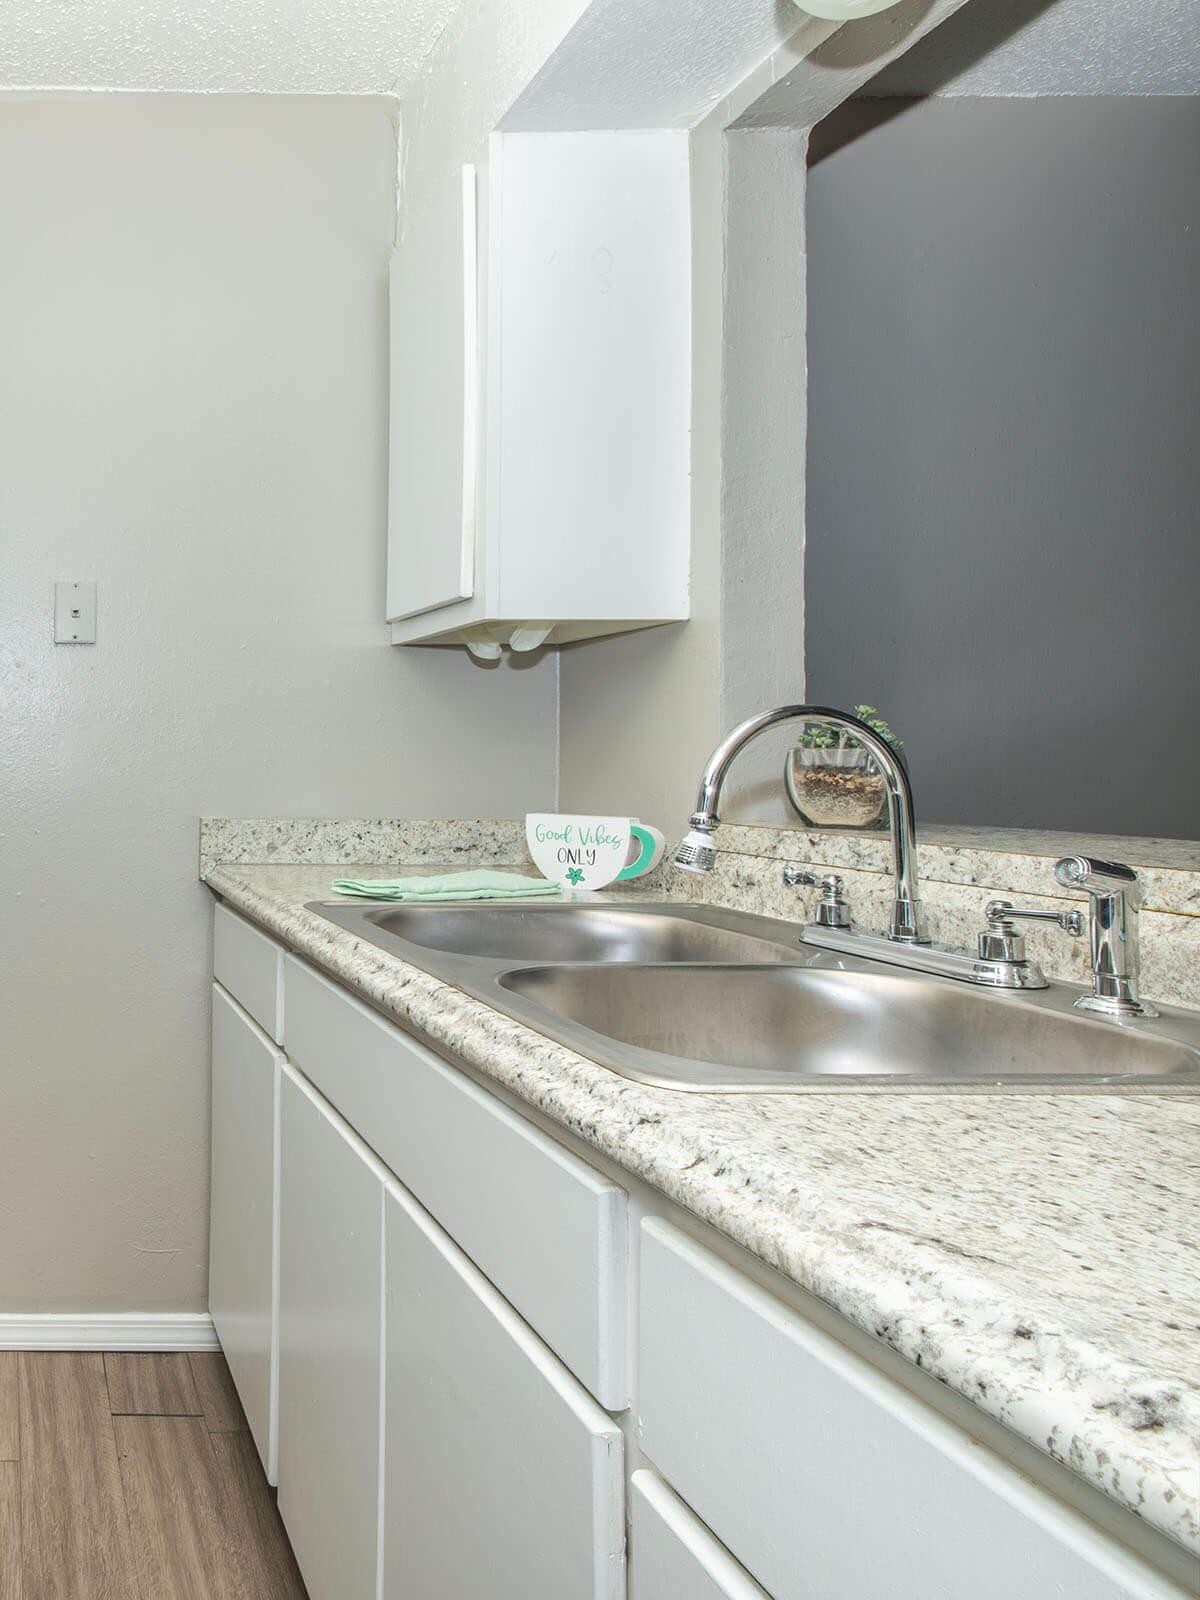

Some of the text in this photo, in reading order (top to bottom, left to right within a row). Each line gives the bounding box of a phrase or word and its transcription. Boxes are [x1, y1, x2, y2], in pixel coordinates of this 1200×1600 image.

[535, 823, 622, 850] Good Vibes
[556, 846, 596, 866] ONLY
